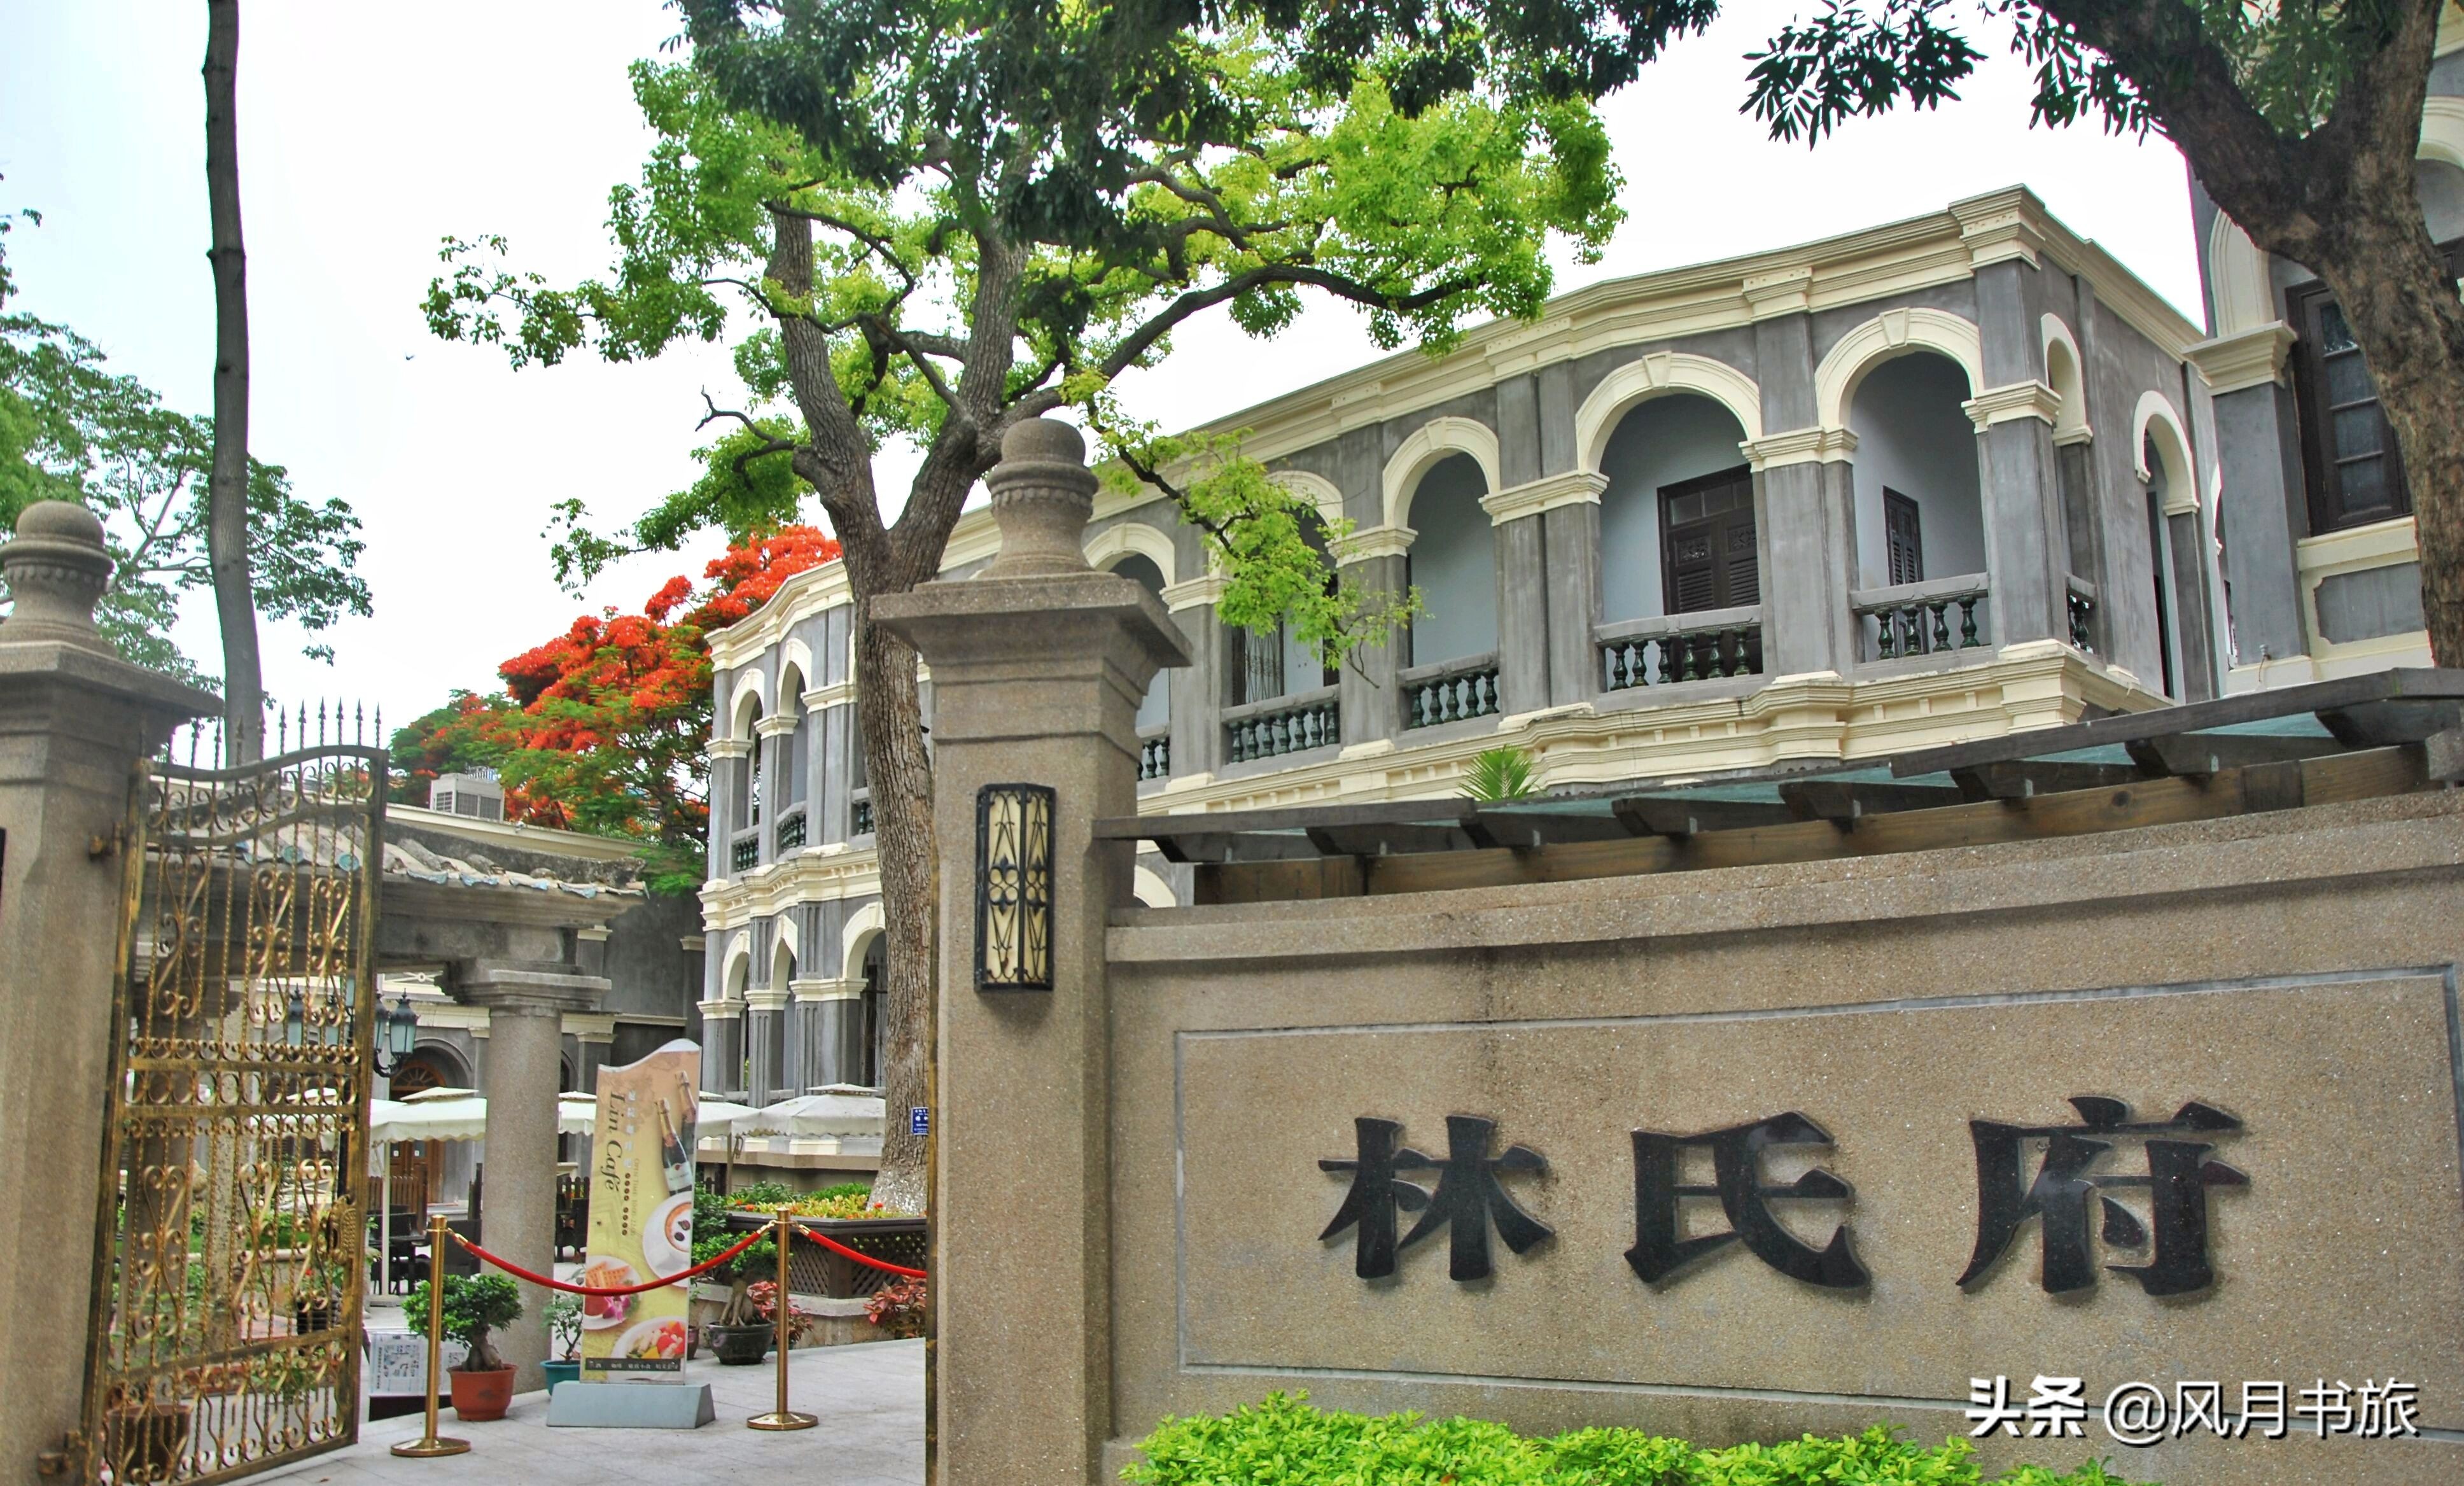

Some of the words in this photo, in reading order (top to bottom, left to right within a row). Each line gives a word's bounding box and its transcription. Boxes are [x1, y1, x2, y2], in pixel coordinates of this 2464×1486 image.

[608, 1090, 626, 1135] Lin
[601, 1140, 622, 1193] Café
[1318, 1096, 2250, 1296] 林氏府
